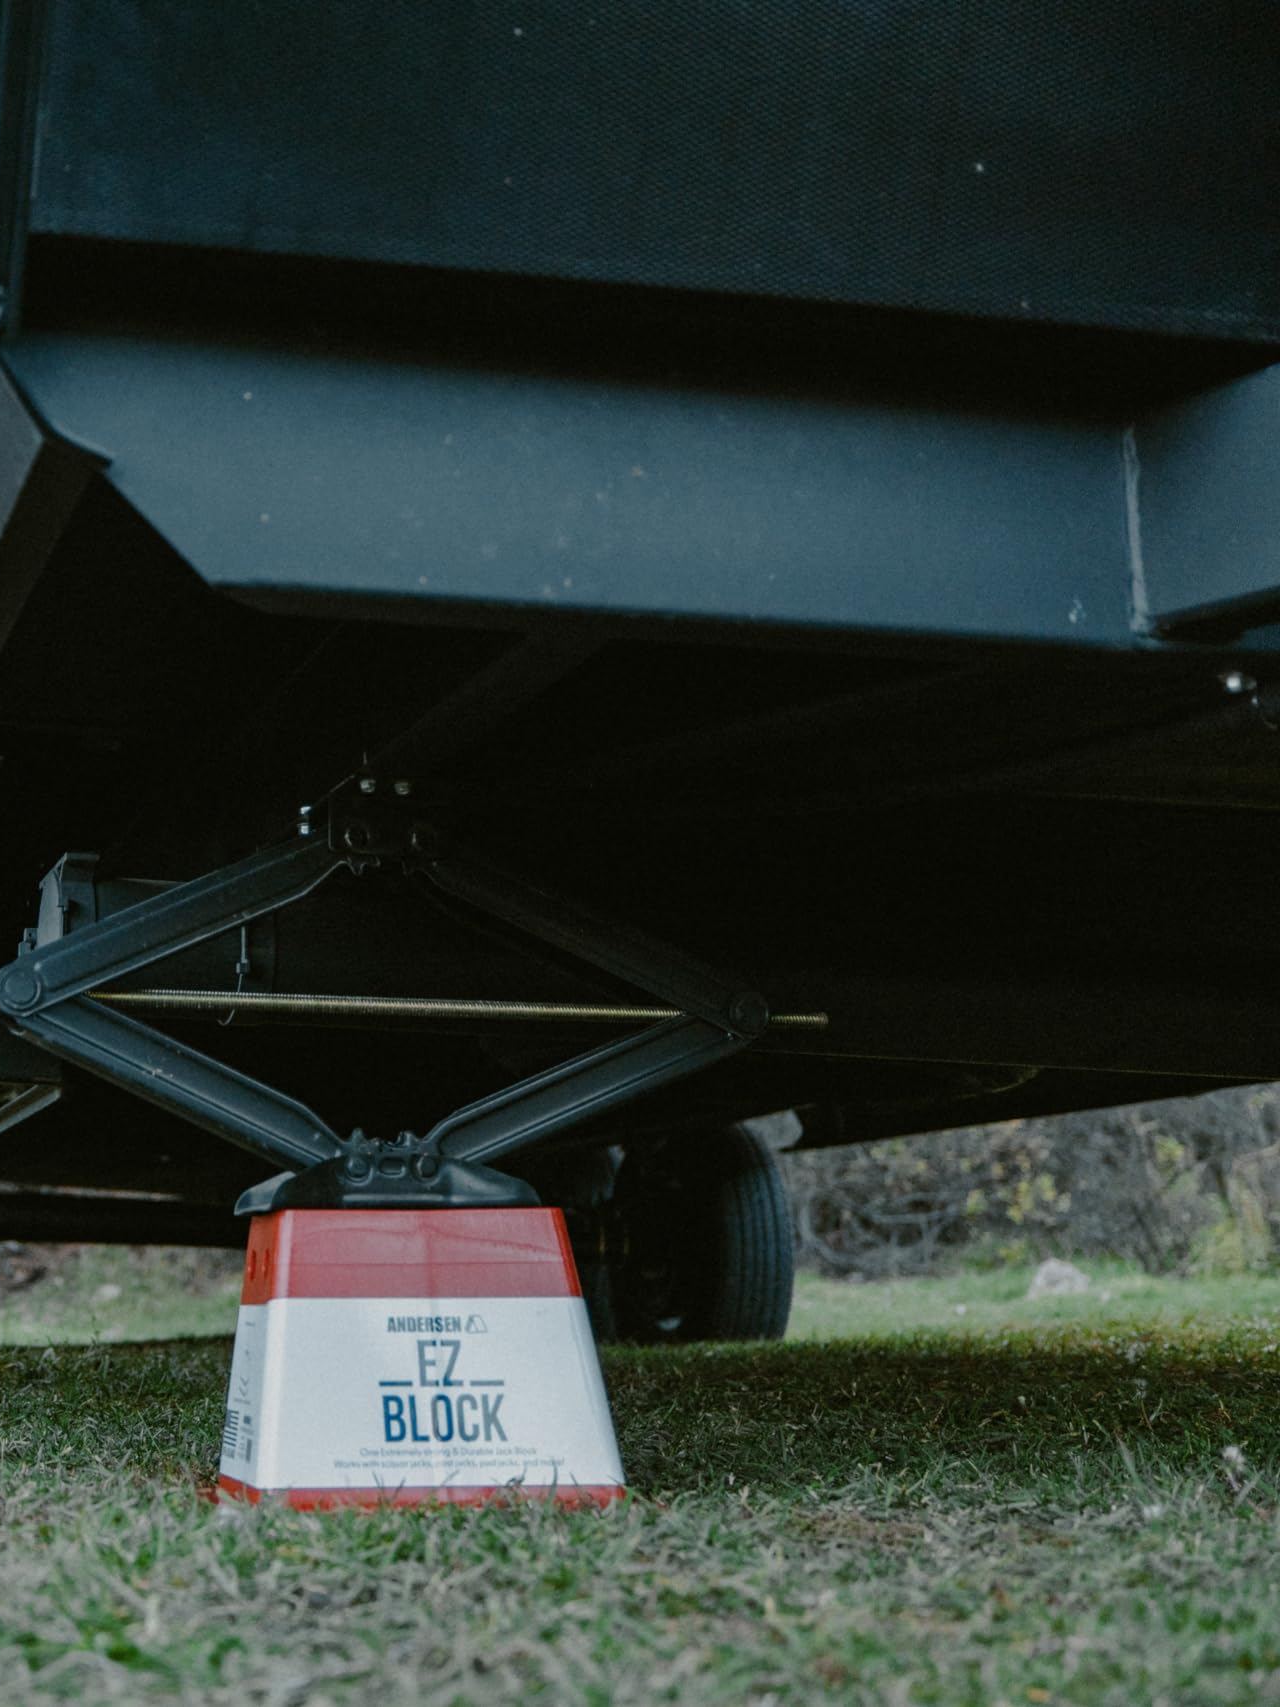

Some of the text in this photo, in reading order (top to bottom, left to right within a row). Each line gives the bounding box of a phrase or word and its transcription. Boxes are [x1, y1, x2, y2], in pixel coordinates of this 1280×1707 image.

[387, 1316, 462, 1333] ANDERSEN
[417, 1340, 464, 1387] EZ
[382, 1394, 508, 1443] BLOCK
